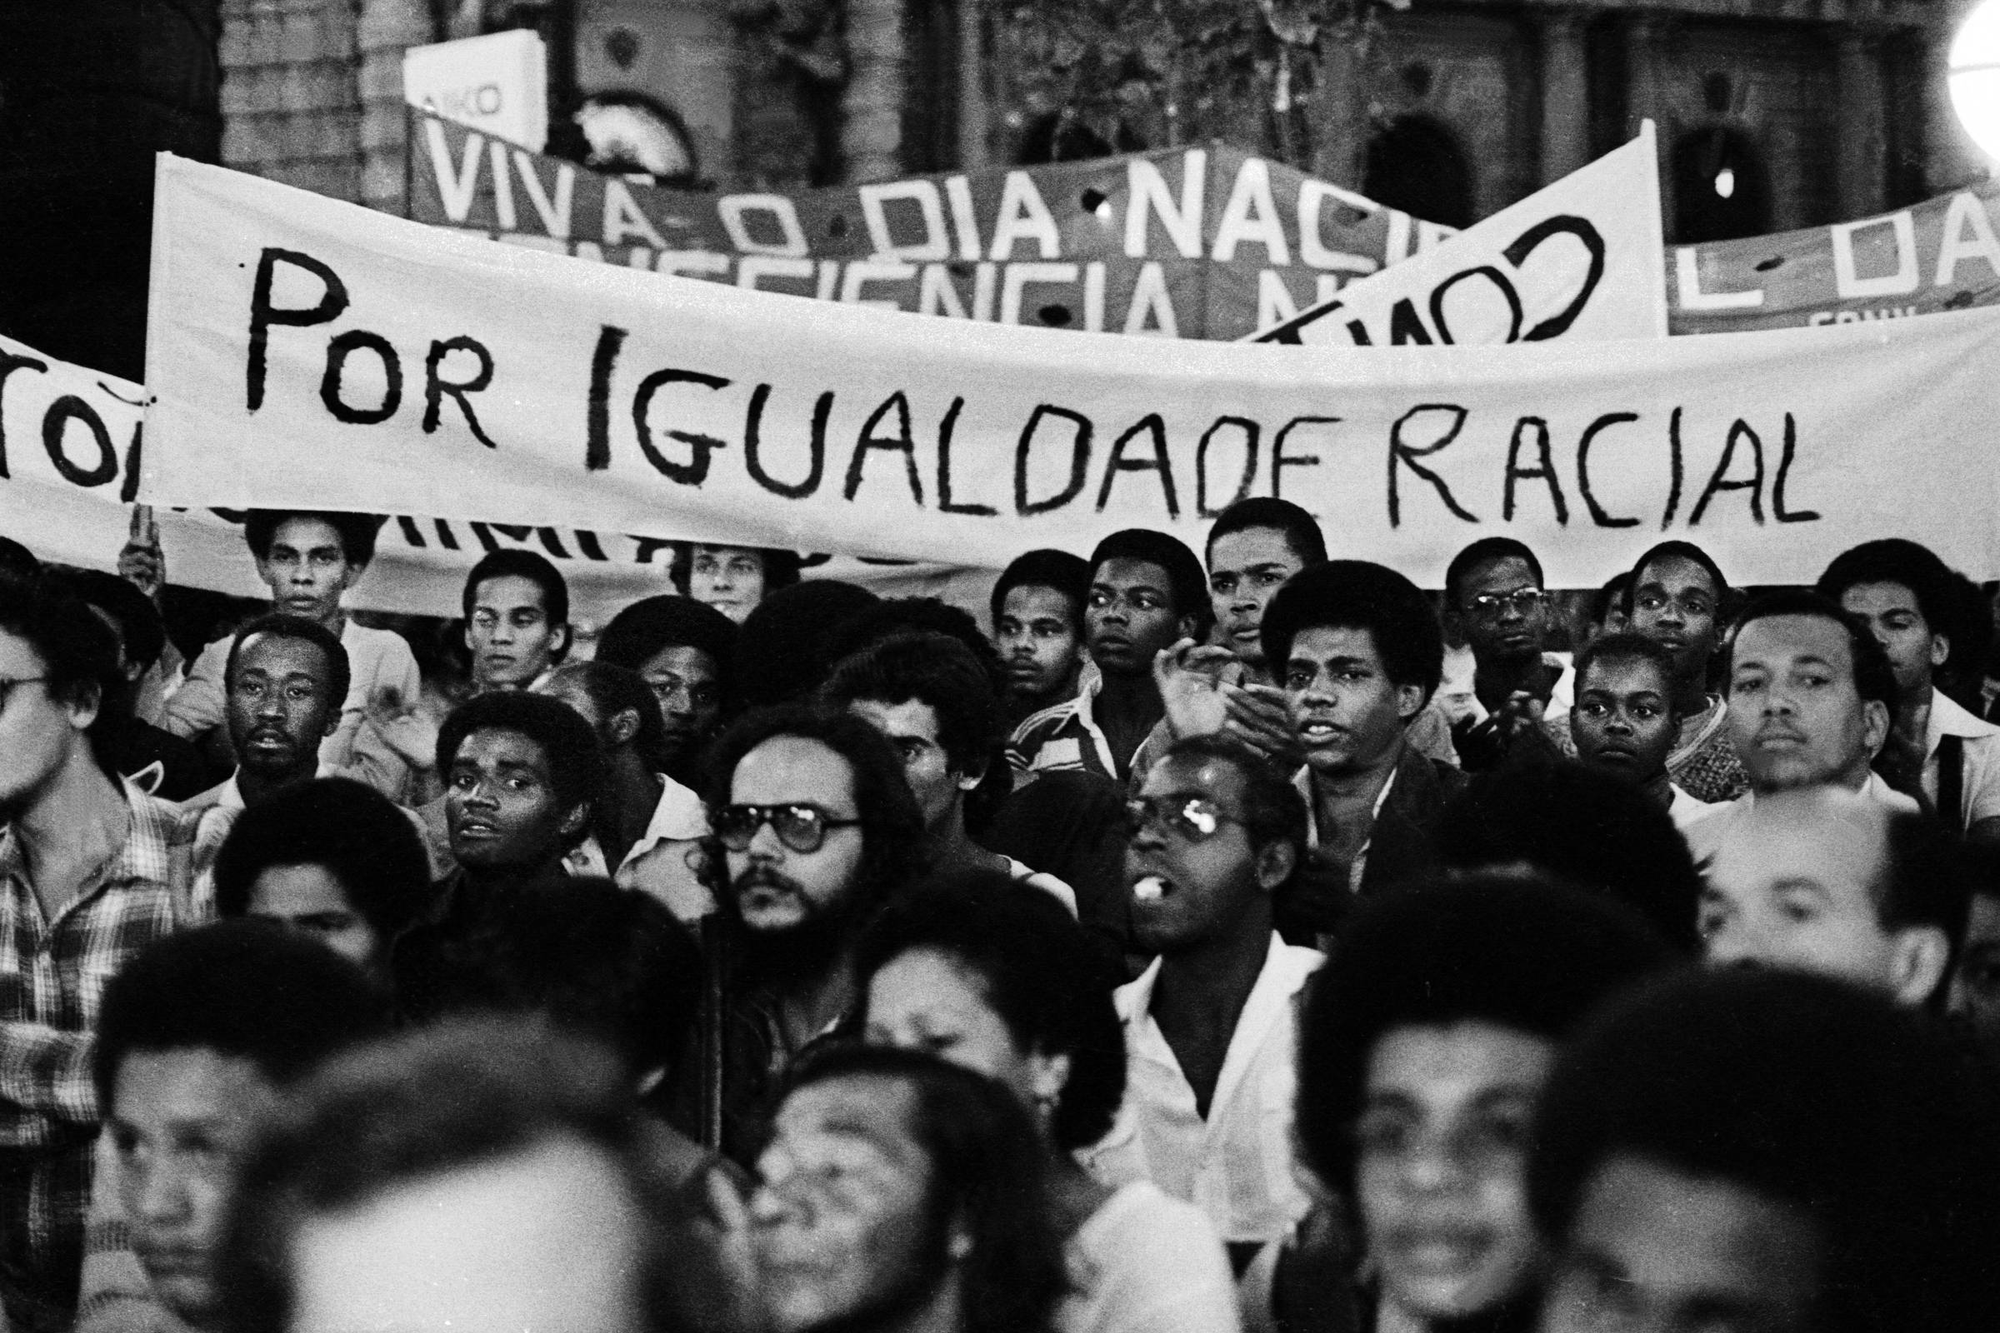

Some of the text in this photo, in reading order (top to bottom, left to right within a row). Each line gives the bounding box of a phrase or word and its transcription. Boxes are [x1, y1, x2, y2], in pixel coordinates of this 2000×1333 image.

[424, 116, 669, 249] VIVA
[716, 193, 809, 258] O
[859, 170, 1061, 262] DIA
[1123, 149, 1461, 272] NACI
[246, 246, 497, 449] POR
[585, 324, 1343, 520] IGUALDADE
[1387, 402, 1822, 532] RACIAL
